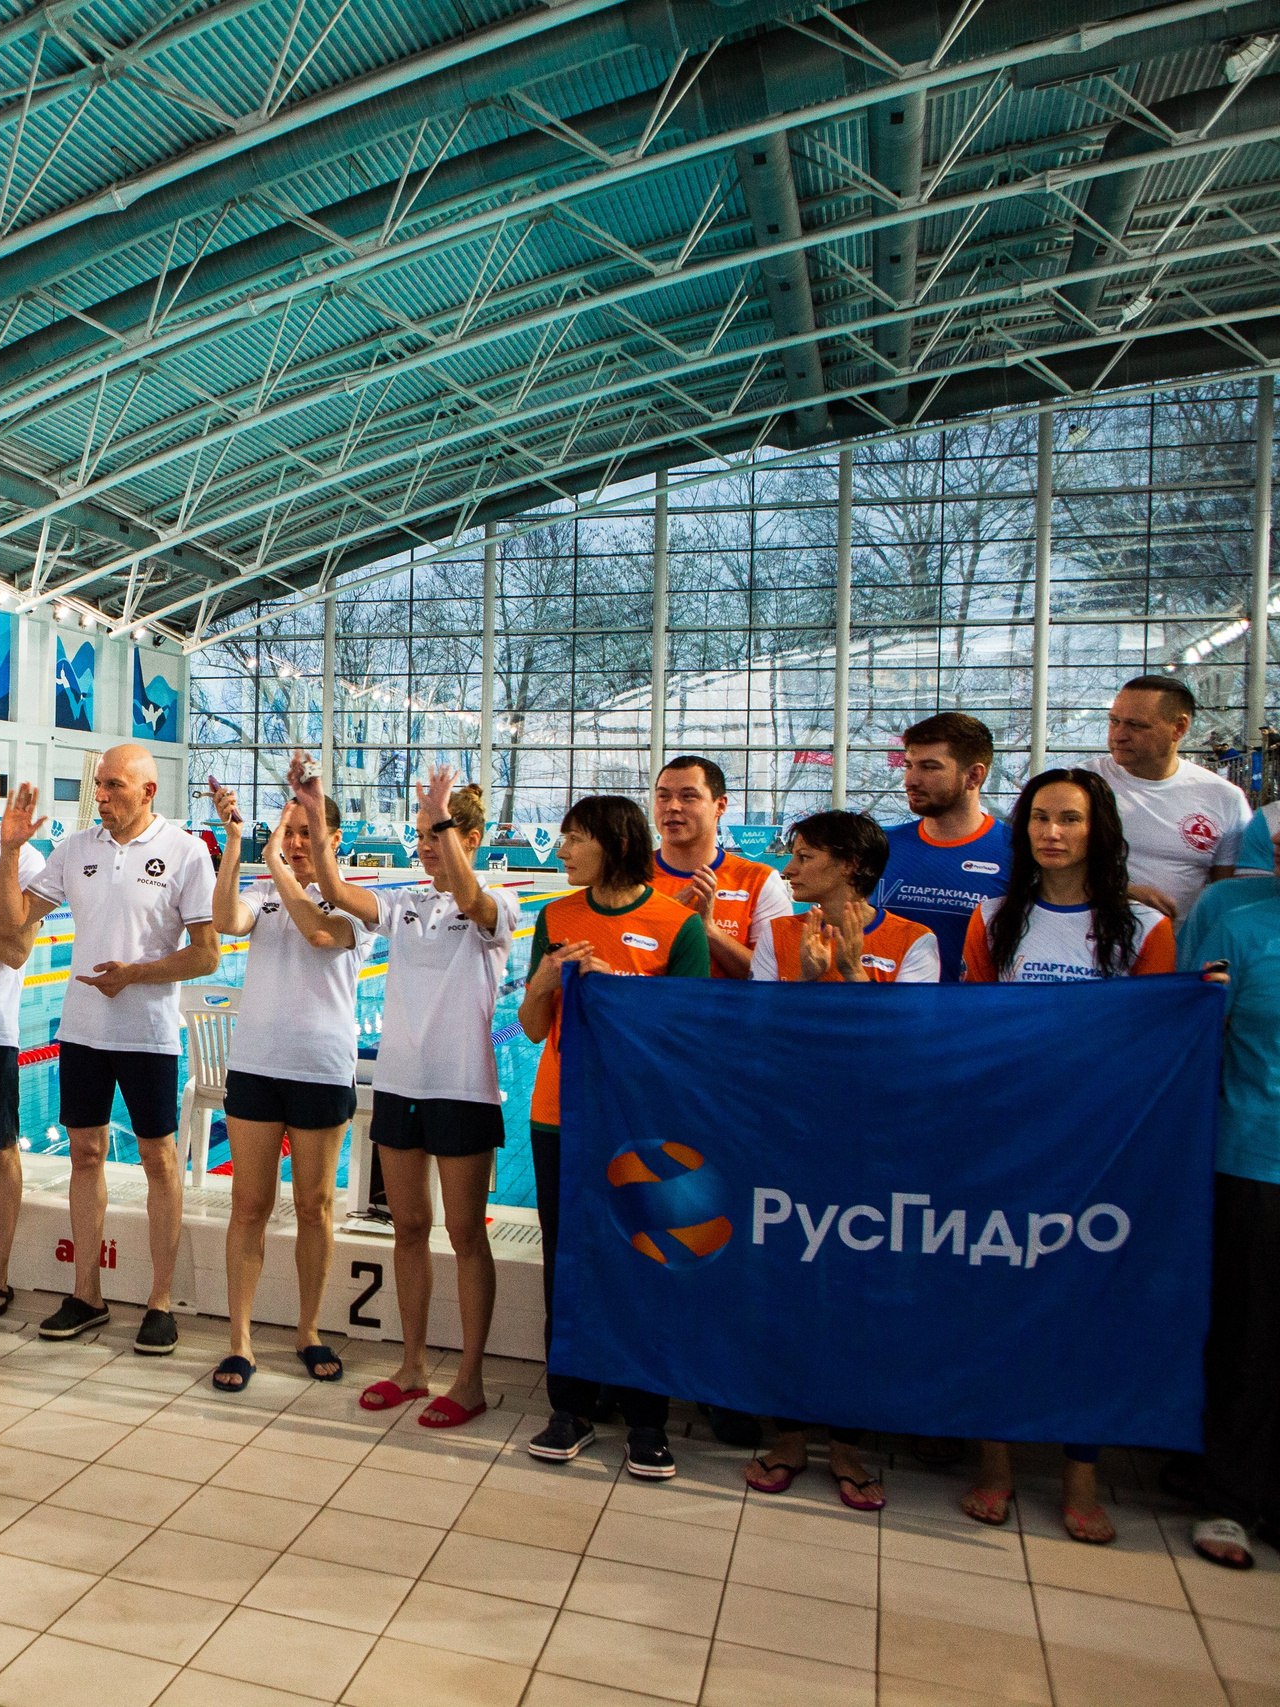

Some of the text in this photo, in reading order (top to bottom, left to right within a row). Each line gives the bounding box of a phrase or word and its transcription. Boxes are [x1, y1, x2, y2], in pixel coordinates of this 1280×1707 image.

[137, 878, 167, 888] РОСАТОМ
[900, 885, 989, 903] СПАРТАКИАДА
[897, 894, 935, 904] ГРУППЫ
[752, 1187, 1130, 1269] РусГидро
[55, 1239, 117, 1269] ati
[349, 1261, 383, 1329] 2
